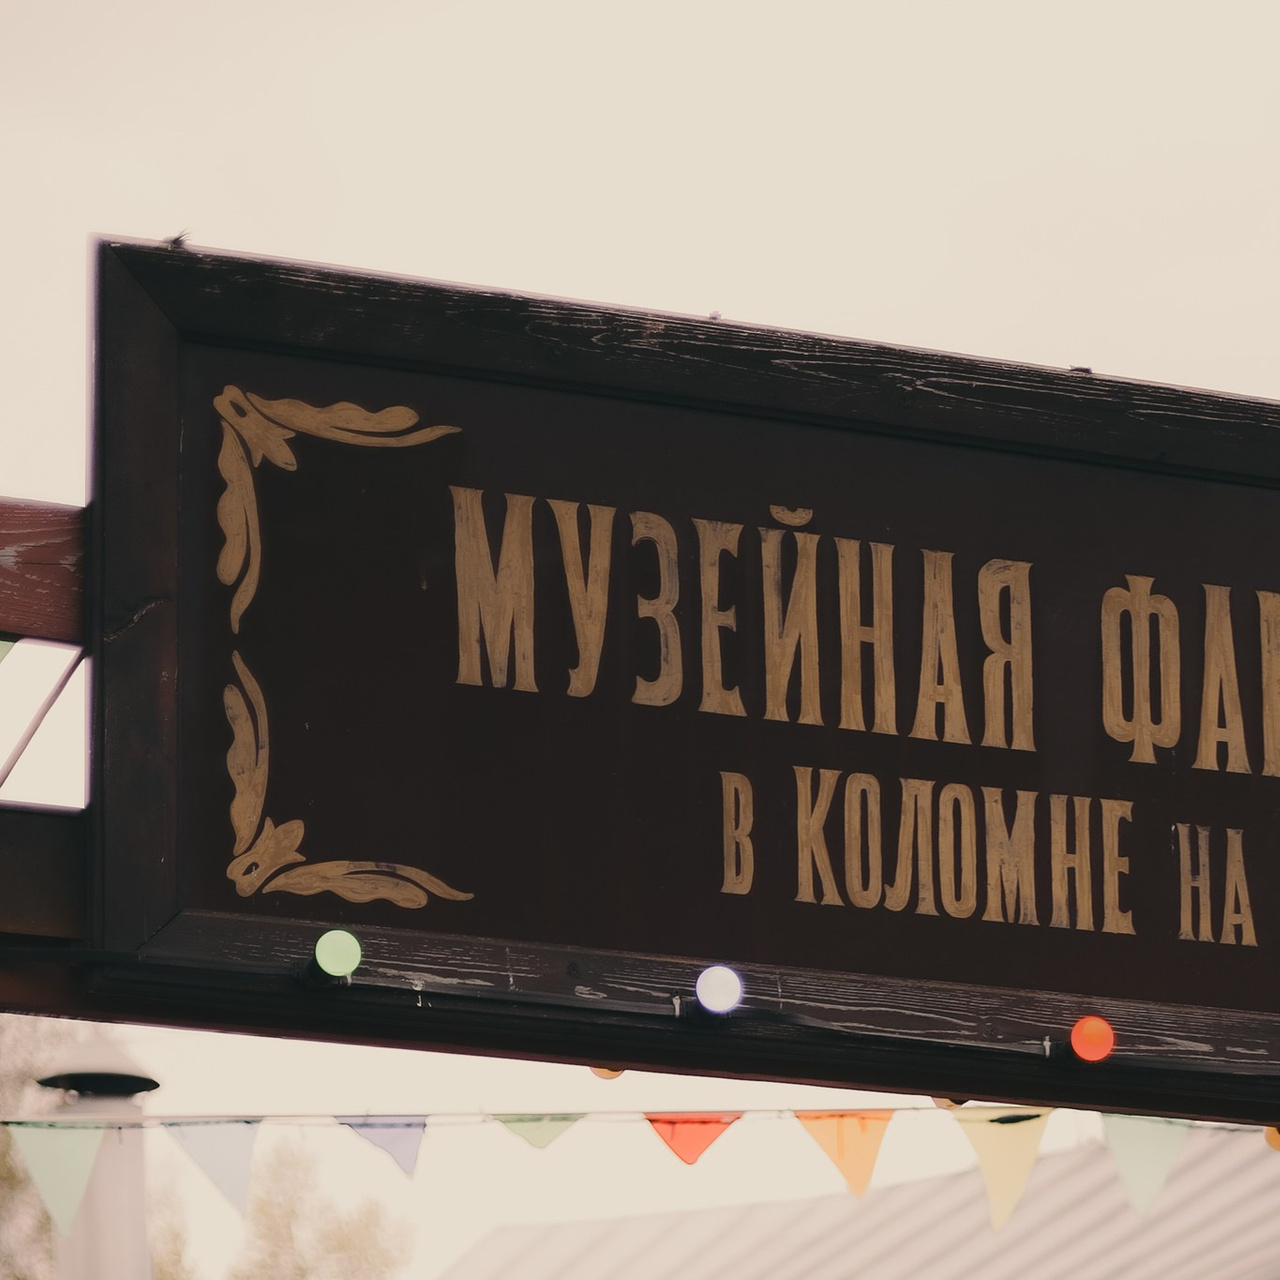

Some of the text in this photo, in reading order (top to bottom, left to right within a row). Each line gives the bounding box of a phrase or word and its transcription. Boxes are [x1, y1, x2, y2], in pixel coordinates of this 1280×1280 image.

[449, 486, 1037, 752] МУЗЕЙНАЯ
[719, 771, 755, 895] В
[793, 766, 1137, 936] КОЛОМНЕ
[1174, 823, 1258, 947] НА
